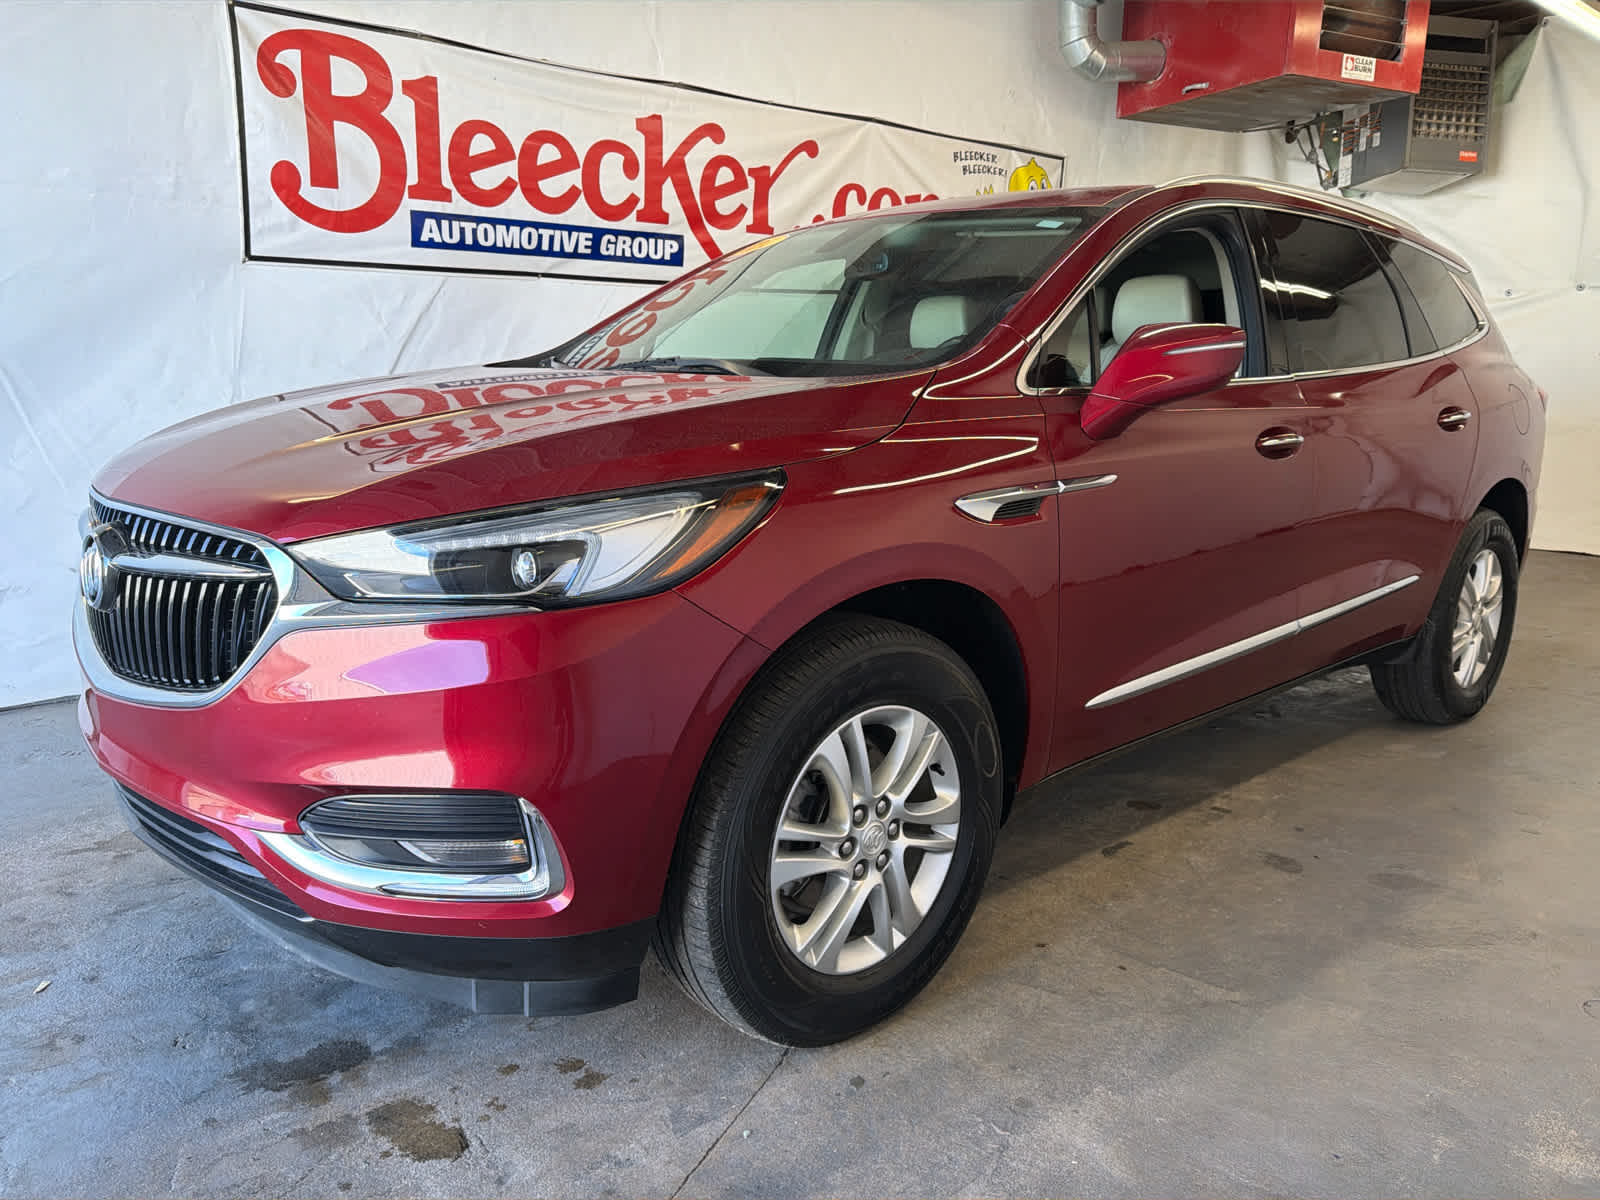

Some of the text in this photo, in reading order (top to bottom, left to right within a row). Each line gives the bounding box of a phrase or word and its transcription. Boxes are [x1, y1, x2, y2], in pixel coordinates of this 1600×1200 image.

[1354, 65, 1373, 74] BURN
[256, 29, 940, 260] Bleecker .co
[420, 218, 679, 260] AUTOMOTIVE GROUP
